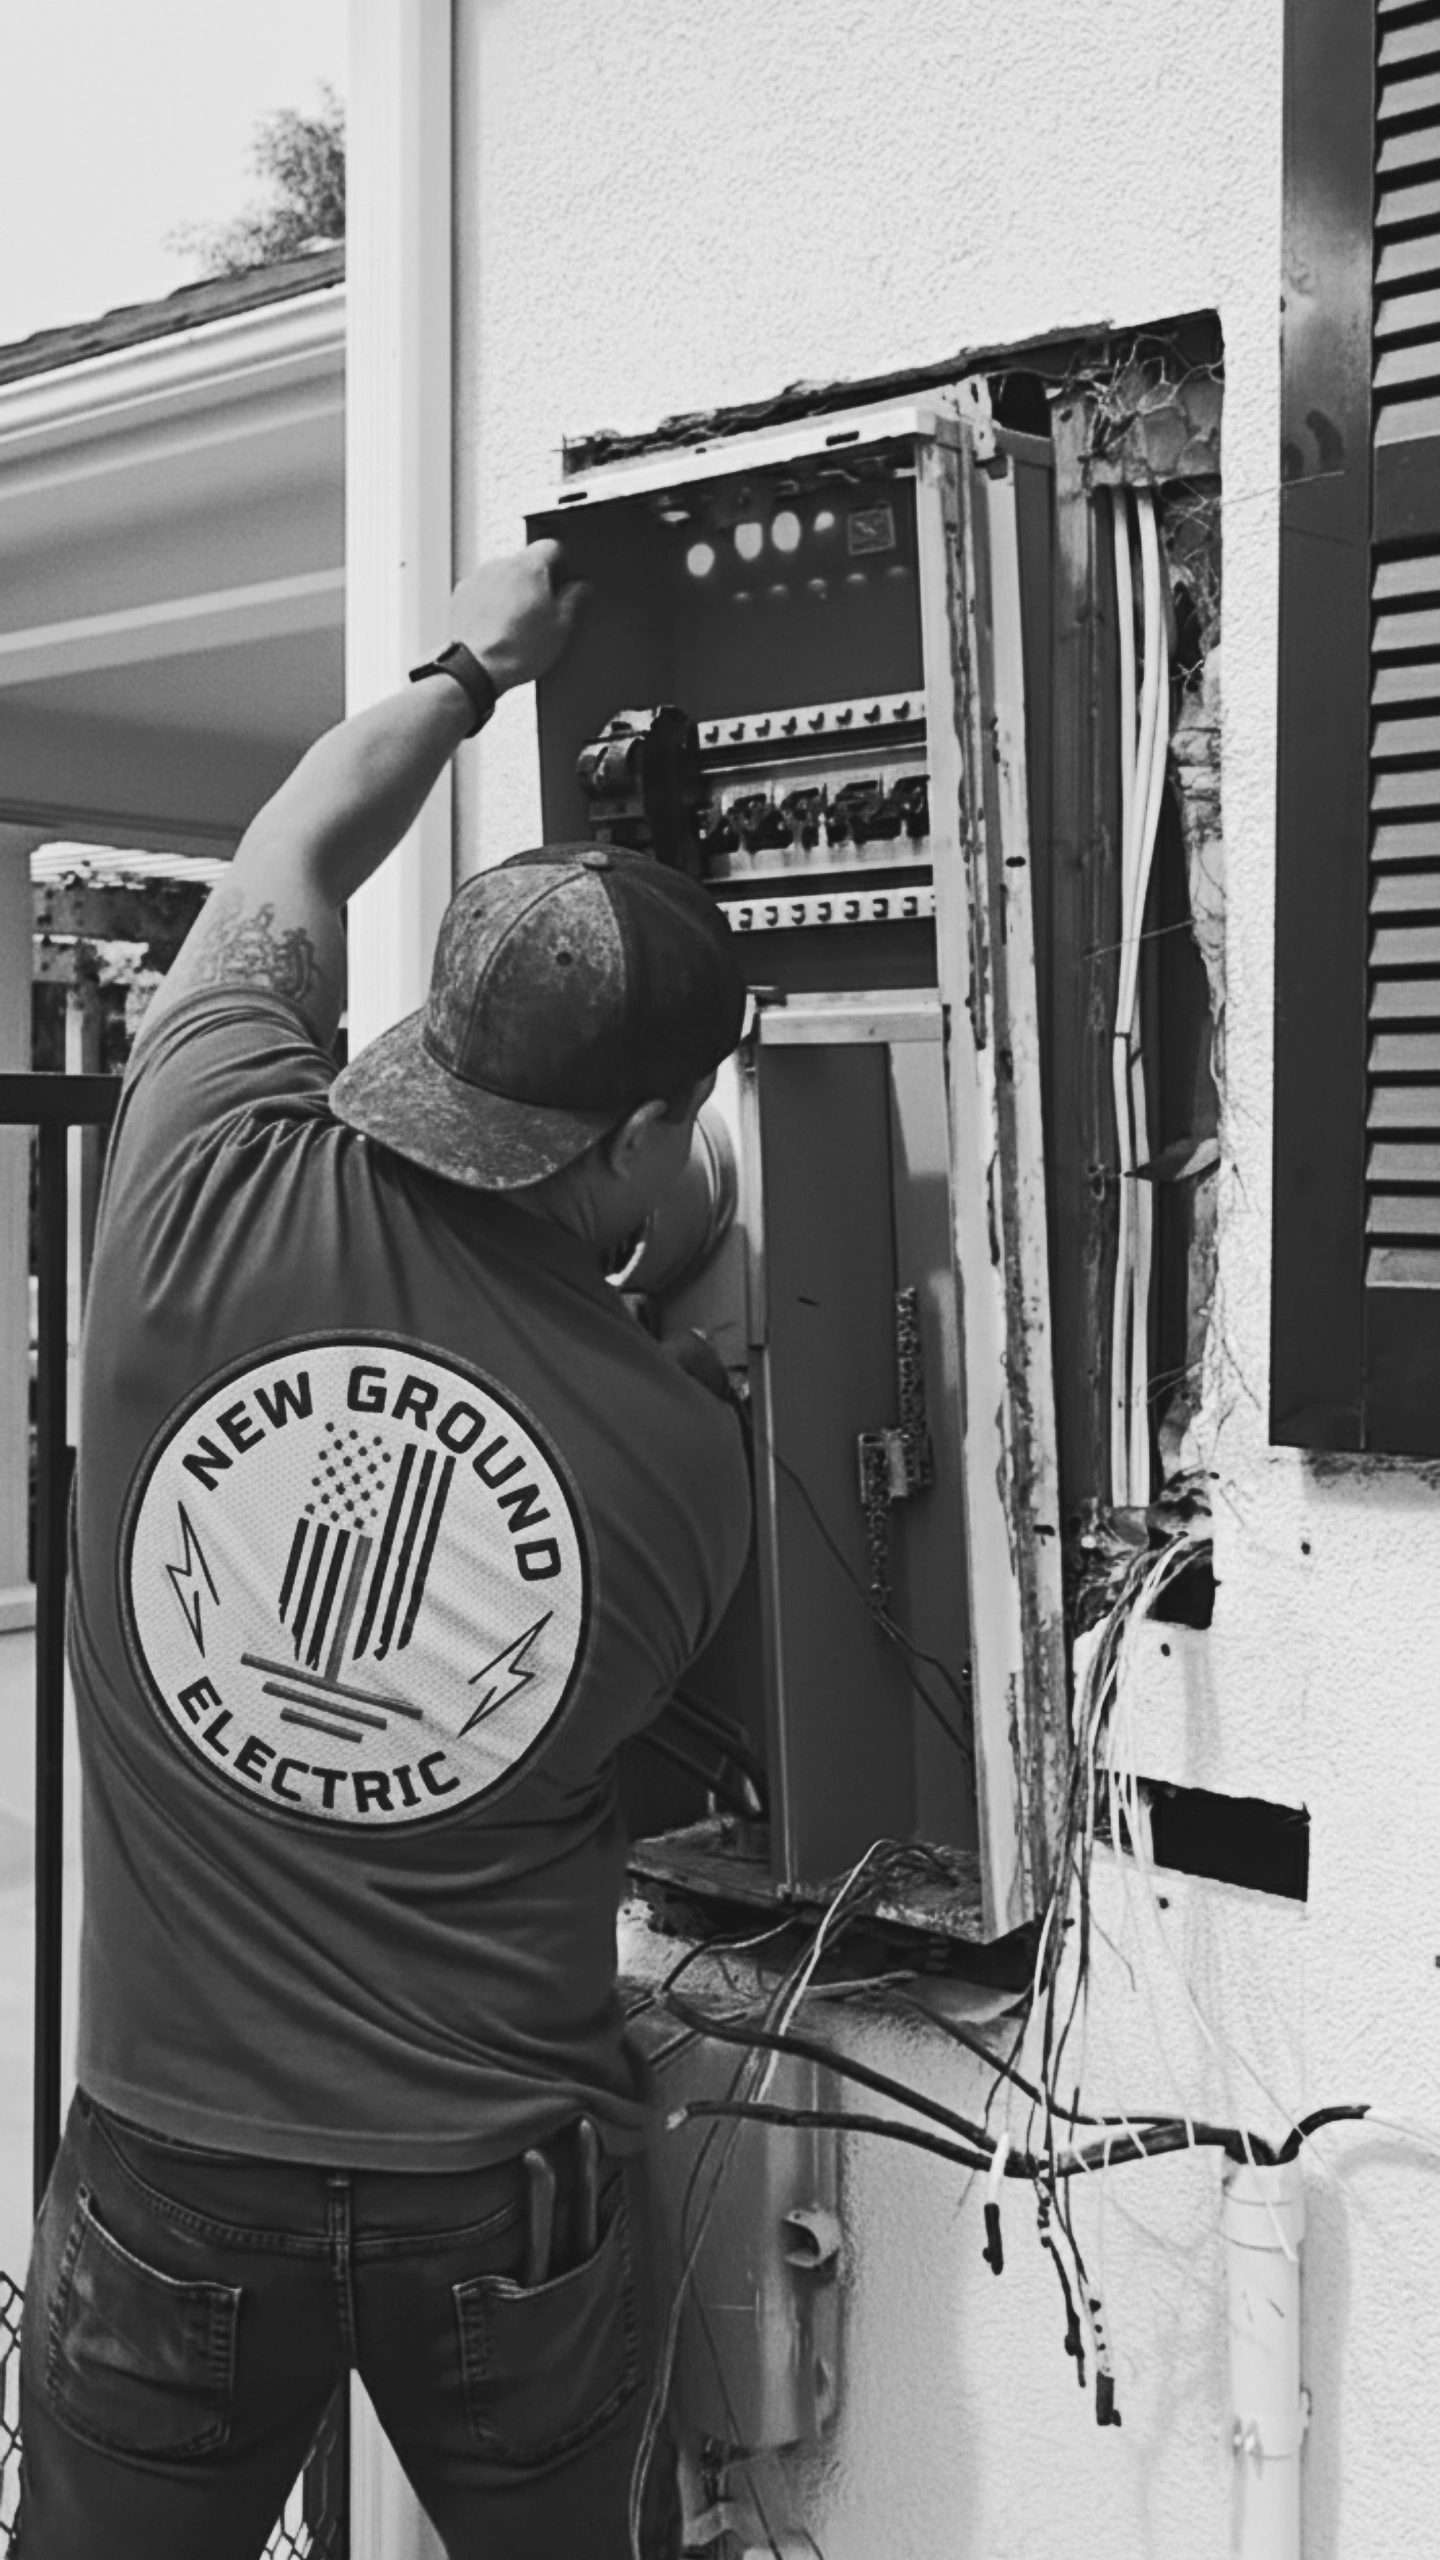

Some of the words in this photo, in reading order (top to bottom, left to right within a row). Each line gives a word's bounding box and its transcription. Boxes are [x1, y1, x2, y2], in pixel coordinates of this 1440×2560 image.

[182, 1371, 313, 1491] NEW
[347, 1365, 562, 1581] GROUND
[177, 1676, 461, 1813] ELECTRIC
